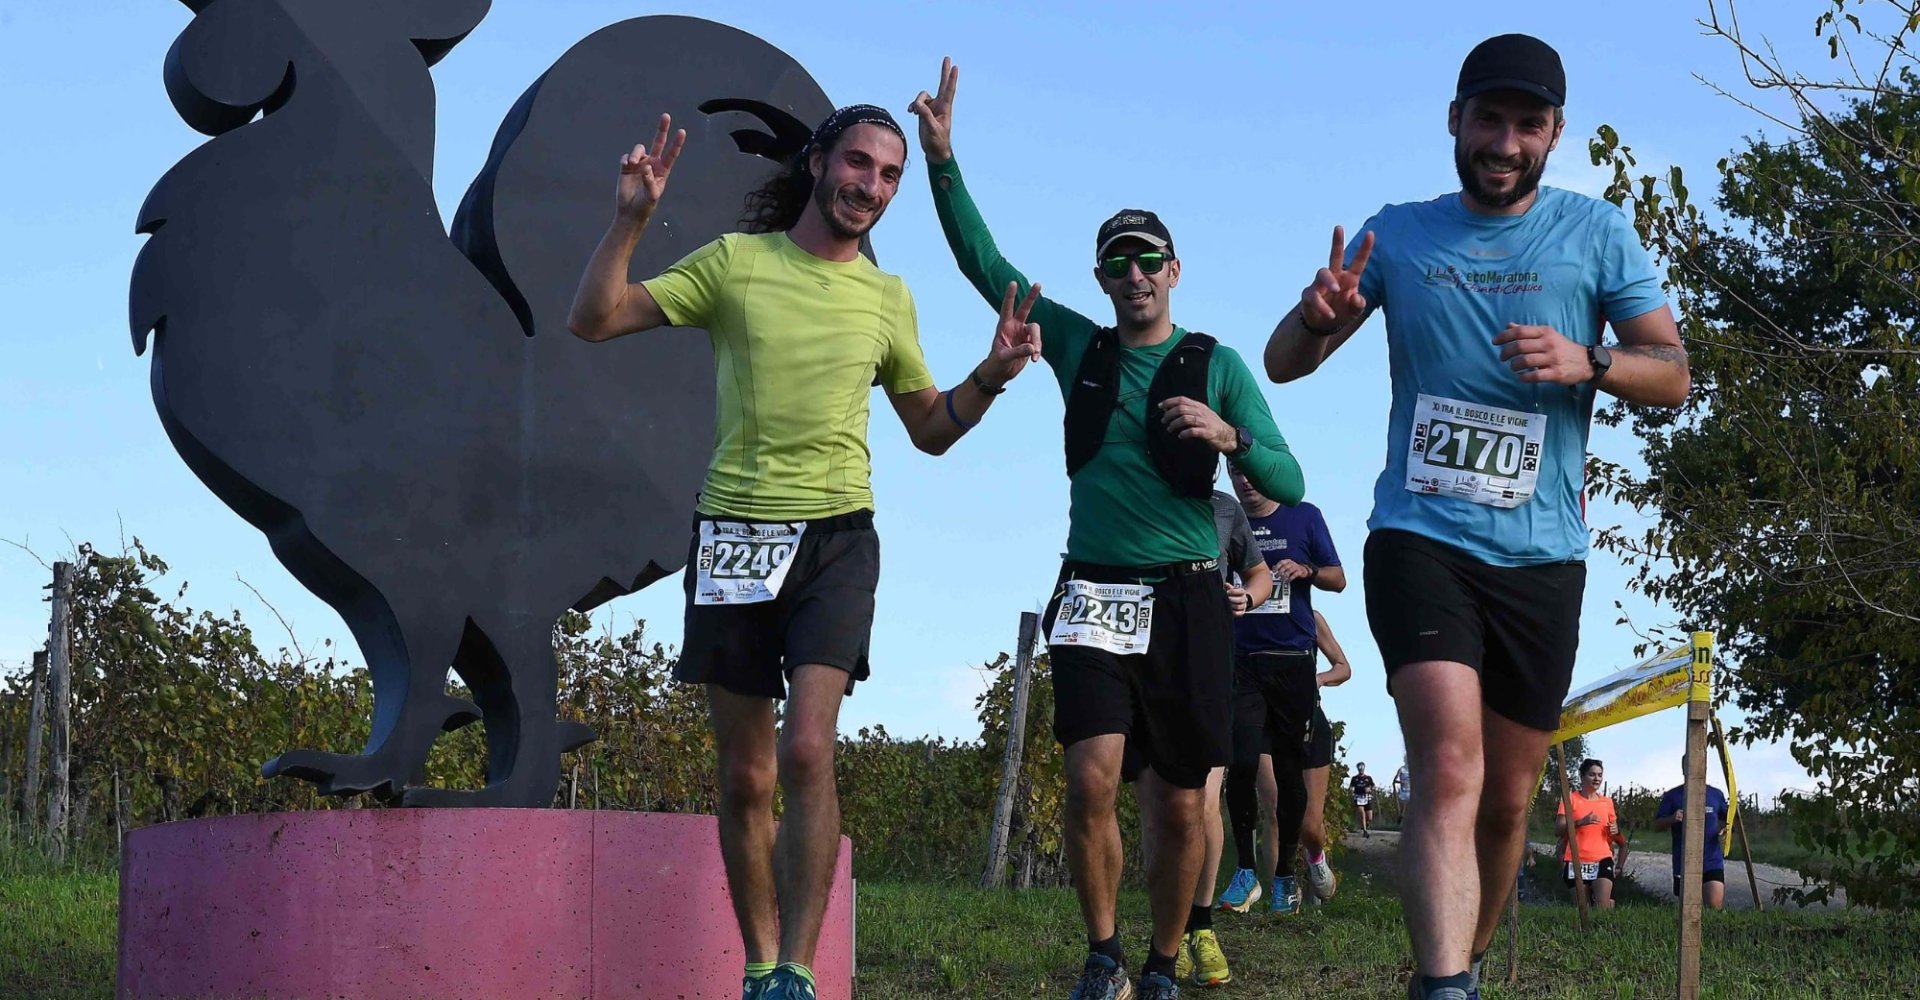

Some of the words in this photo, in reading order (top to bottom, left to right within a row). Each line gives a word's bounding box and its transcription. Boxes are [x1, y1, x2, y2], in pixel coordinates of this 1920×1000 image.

[1441, 404, 1454, 414] TRA
[1464, 408, 1489, 421] BOSCO
[1490, 413, 1496, 422] E
[1497, 414, 1506, 423] LE
[1507, 417, 1529, 427] VIGNE
[1426, 423, 1522, 475] 2170
[712, 542, 791, 576] 2249
[1070, 596, 1136, 633] 2243
